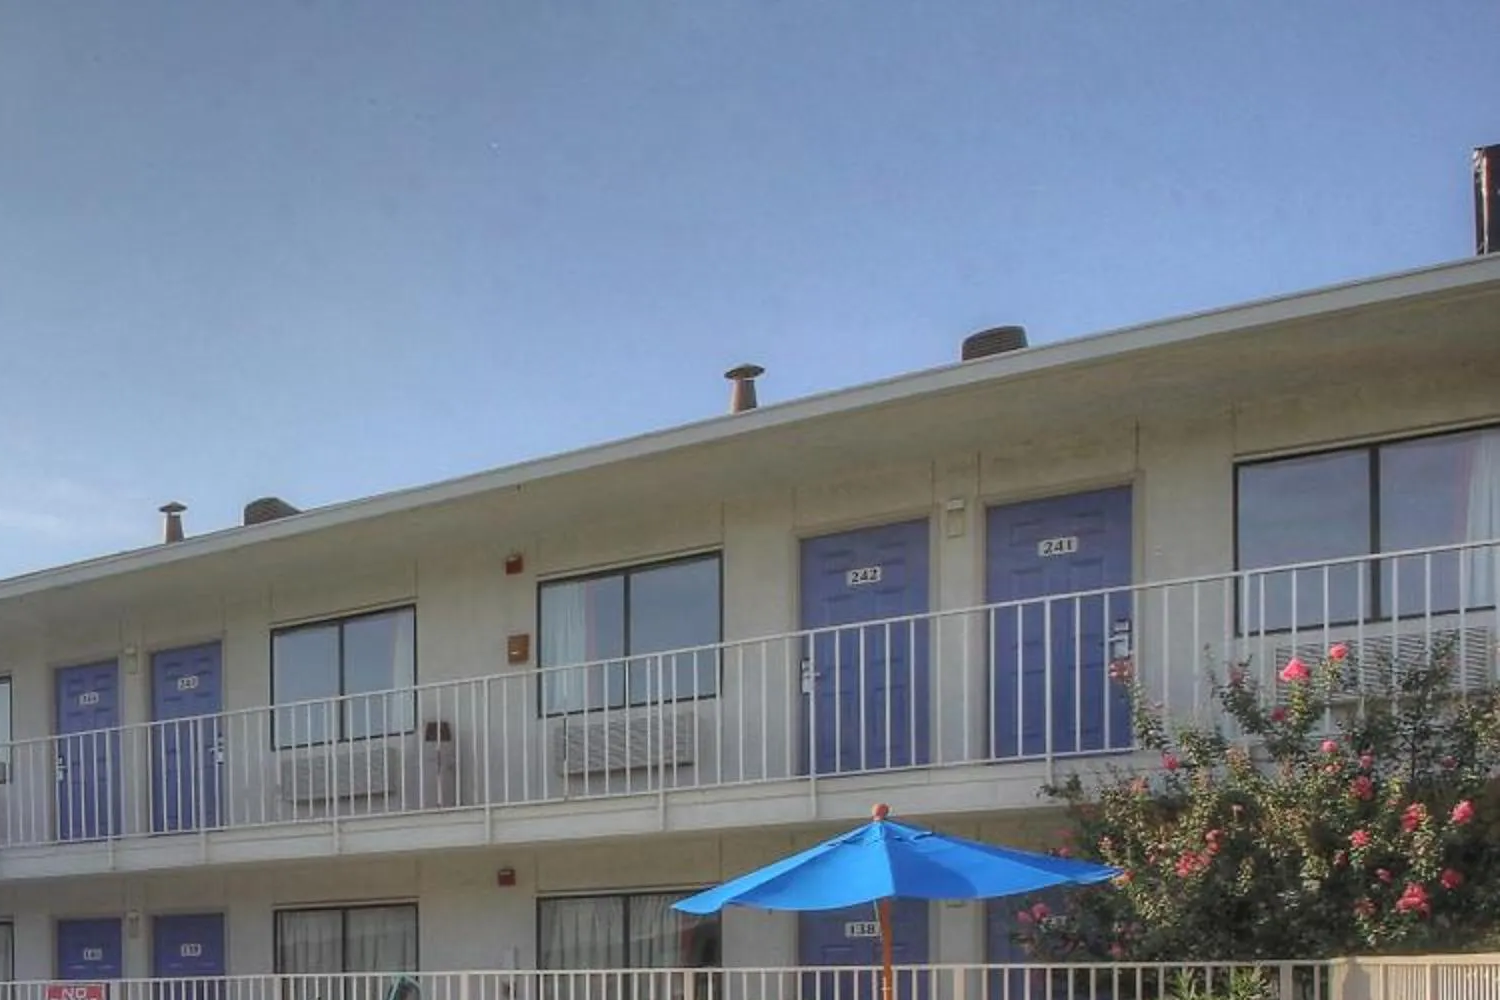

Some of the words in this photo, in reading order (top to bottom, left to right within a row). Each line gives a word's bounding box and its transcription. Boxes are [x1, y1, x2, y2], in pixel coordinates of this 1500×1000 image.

[1042, 538, 1075, 555] 241
[850, 568, 880, 584] 242
[850, 922, 876, 936] 138
[62, 987, 88, 999] NO
